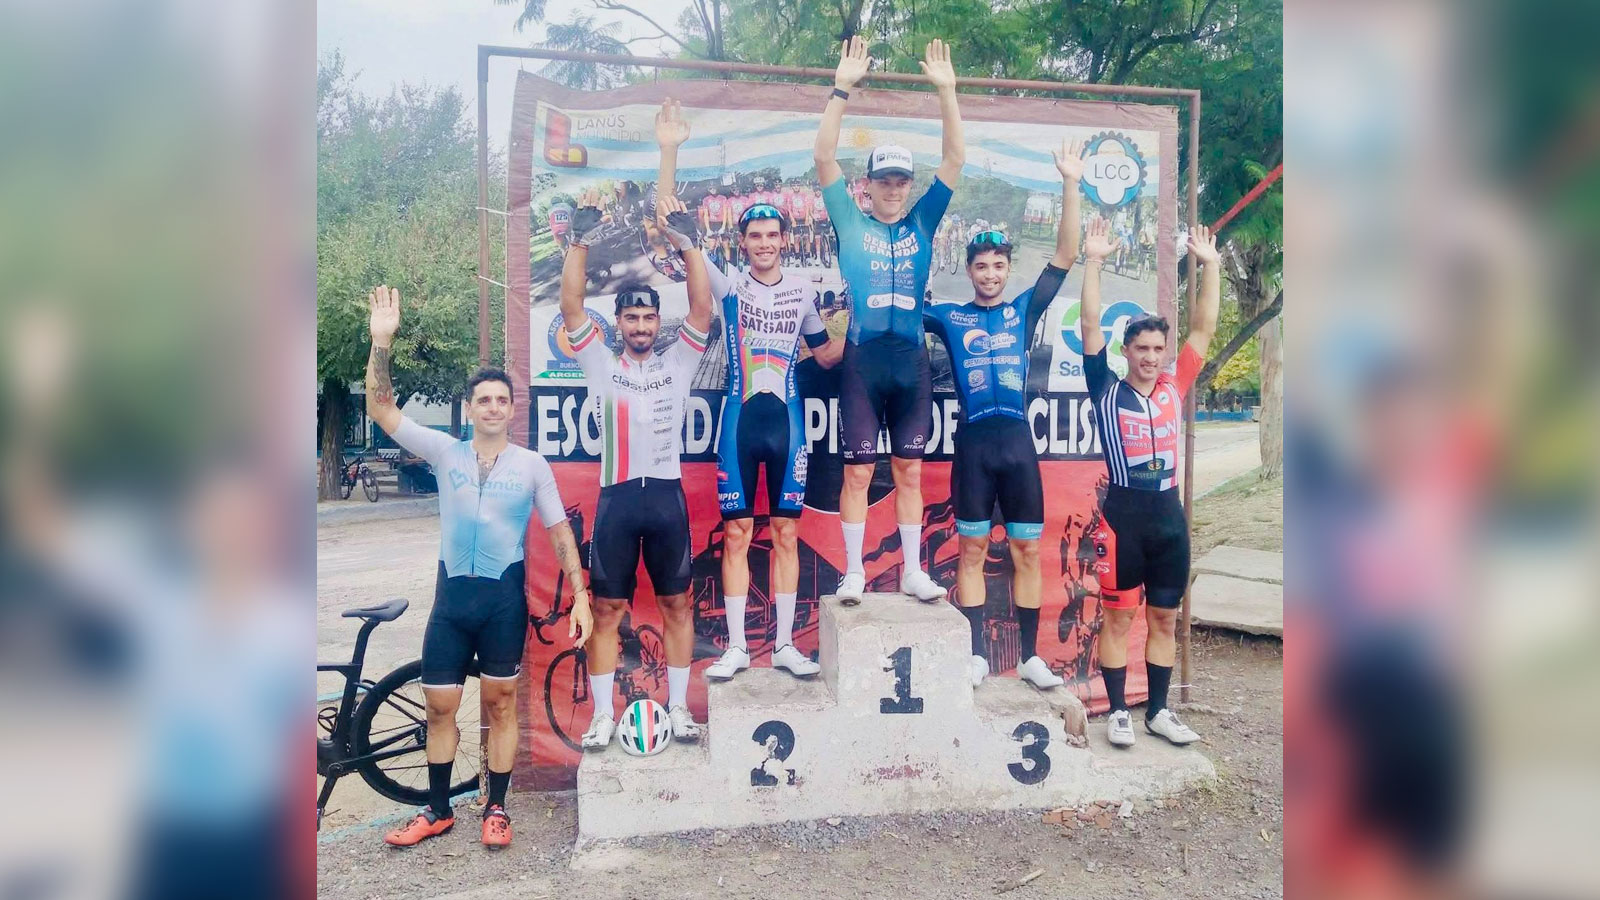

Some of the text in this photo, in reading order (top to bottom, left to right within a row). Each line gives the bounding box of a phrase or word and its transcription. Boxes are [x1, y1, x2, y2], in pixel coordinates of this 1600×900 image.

[577, 114, 626, 131] LANÚS
[1094, 163, 1131, 181] LCC
[773, 288, 803, 301] DIRECTV
[740, 300, 798, 320] TELEVISION
[612, 374, 673, 393] classique
[1123, 419, 1177, 440] IRON
[880, 647, 924, 714] 1
[751, 719, 796, 787] 2
[1007, 720, 1051, 786] 3
